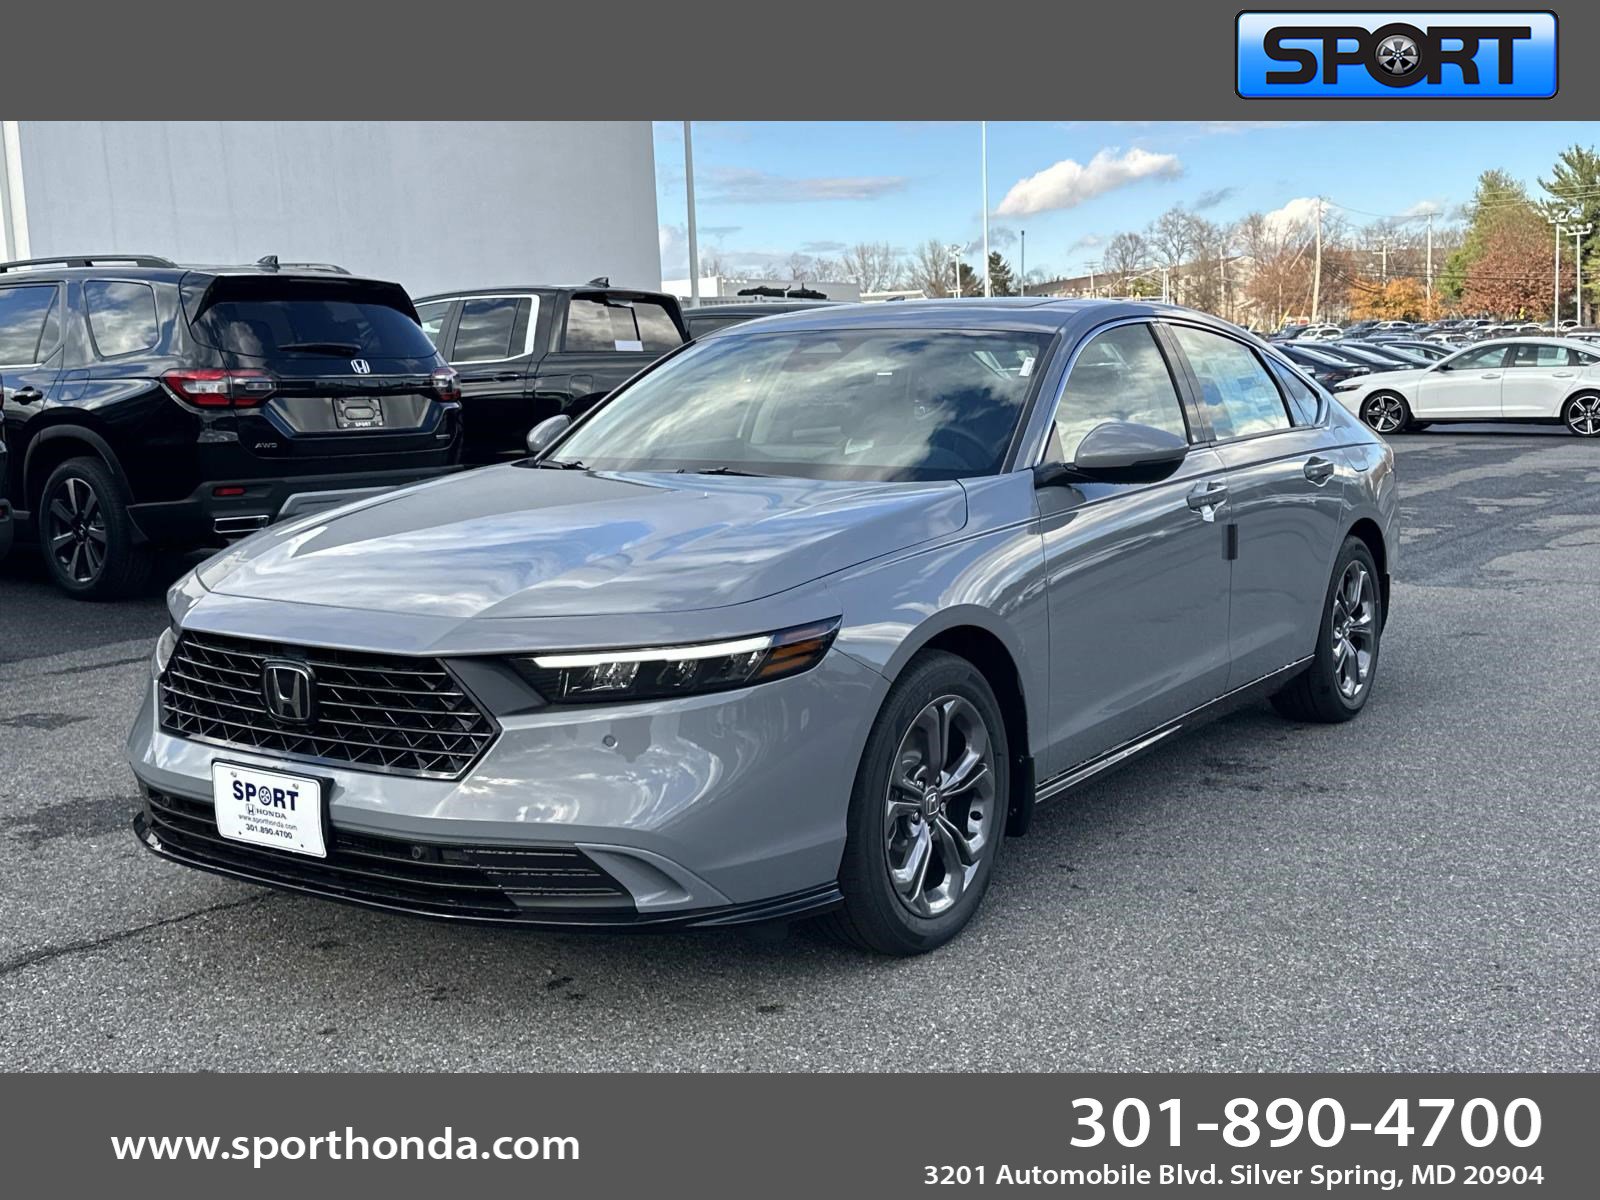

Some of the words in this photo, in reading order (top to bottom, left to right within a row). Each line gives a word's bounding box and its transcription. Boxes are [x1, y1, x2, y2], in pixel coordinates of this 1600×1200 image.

[232, 780, 299, 811] SPORT
[256, 807, 287, 820] HONDA
[245, 823, 293, 840] 301.890.4700
